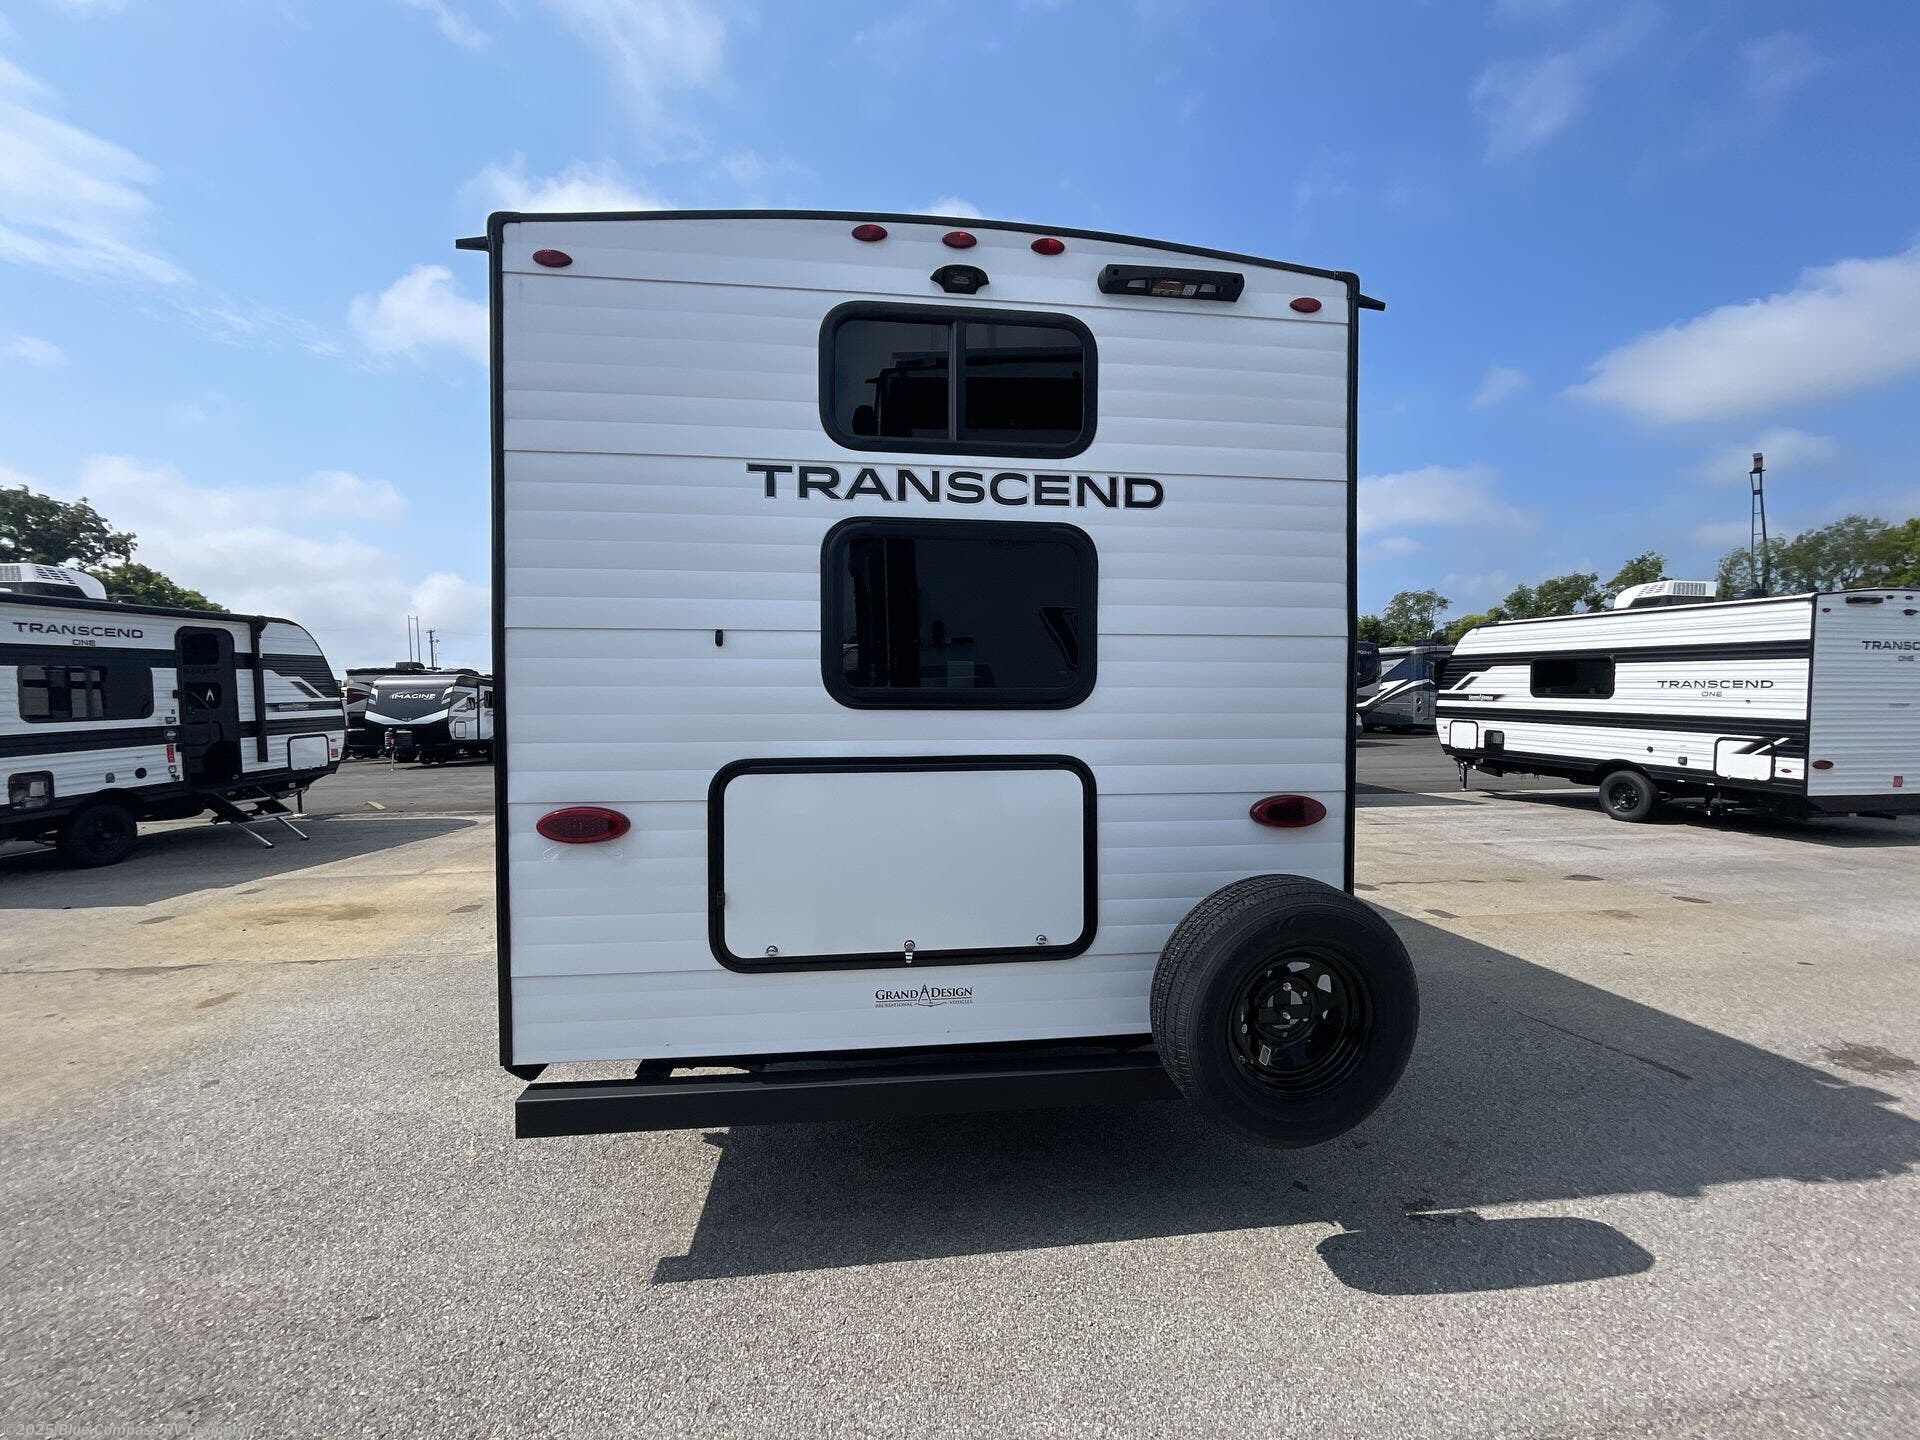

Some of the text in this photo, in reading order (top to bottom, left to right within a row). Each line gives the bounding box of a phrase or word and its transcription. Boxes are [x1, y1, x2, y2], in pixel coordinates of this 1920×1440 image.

[747, 463, 1164, 509] TRANSCEND
[13, 621, 144, 638] TRANSCEND
[1657, 680, 1774, 689] TRANSCEND
[875, 987, 973, 1000] GRAND DESIGN
